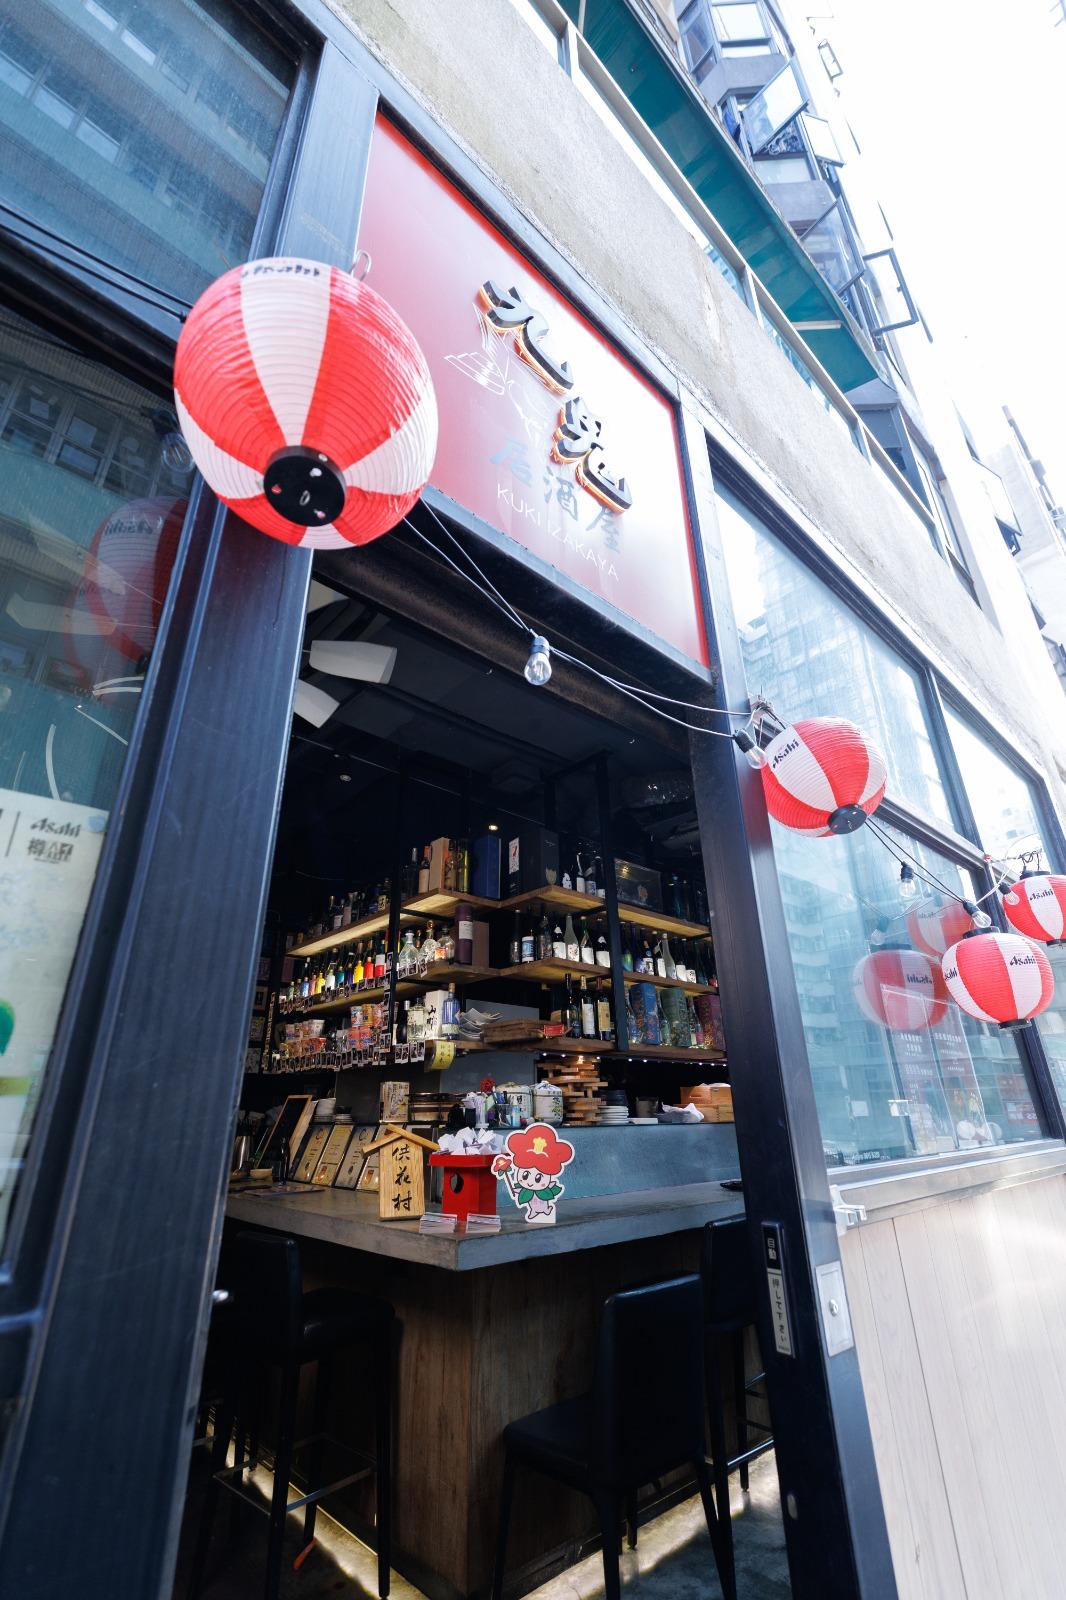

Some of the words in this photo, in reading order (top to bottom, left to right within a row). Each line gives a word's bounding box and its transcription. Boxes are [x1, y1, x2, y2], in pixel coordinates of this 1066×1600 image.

[497, 483, 541, 527] KUKI
[547, 519, 620, 582] IZAKAYA
[772, 739, 800, 769] Asahi
[30, 817, 82, 838] Asahi
[1029, 888, 1055, 901] Asahi
[1009, 955, 1037, 967] Asahi
